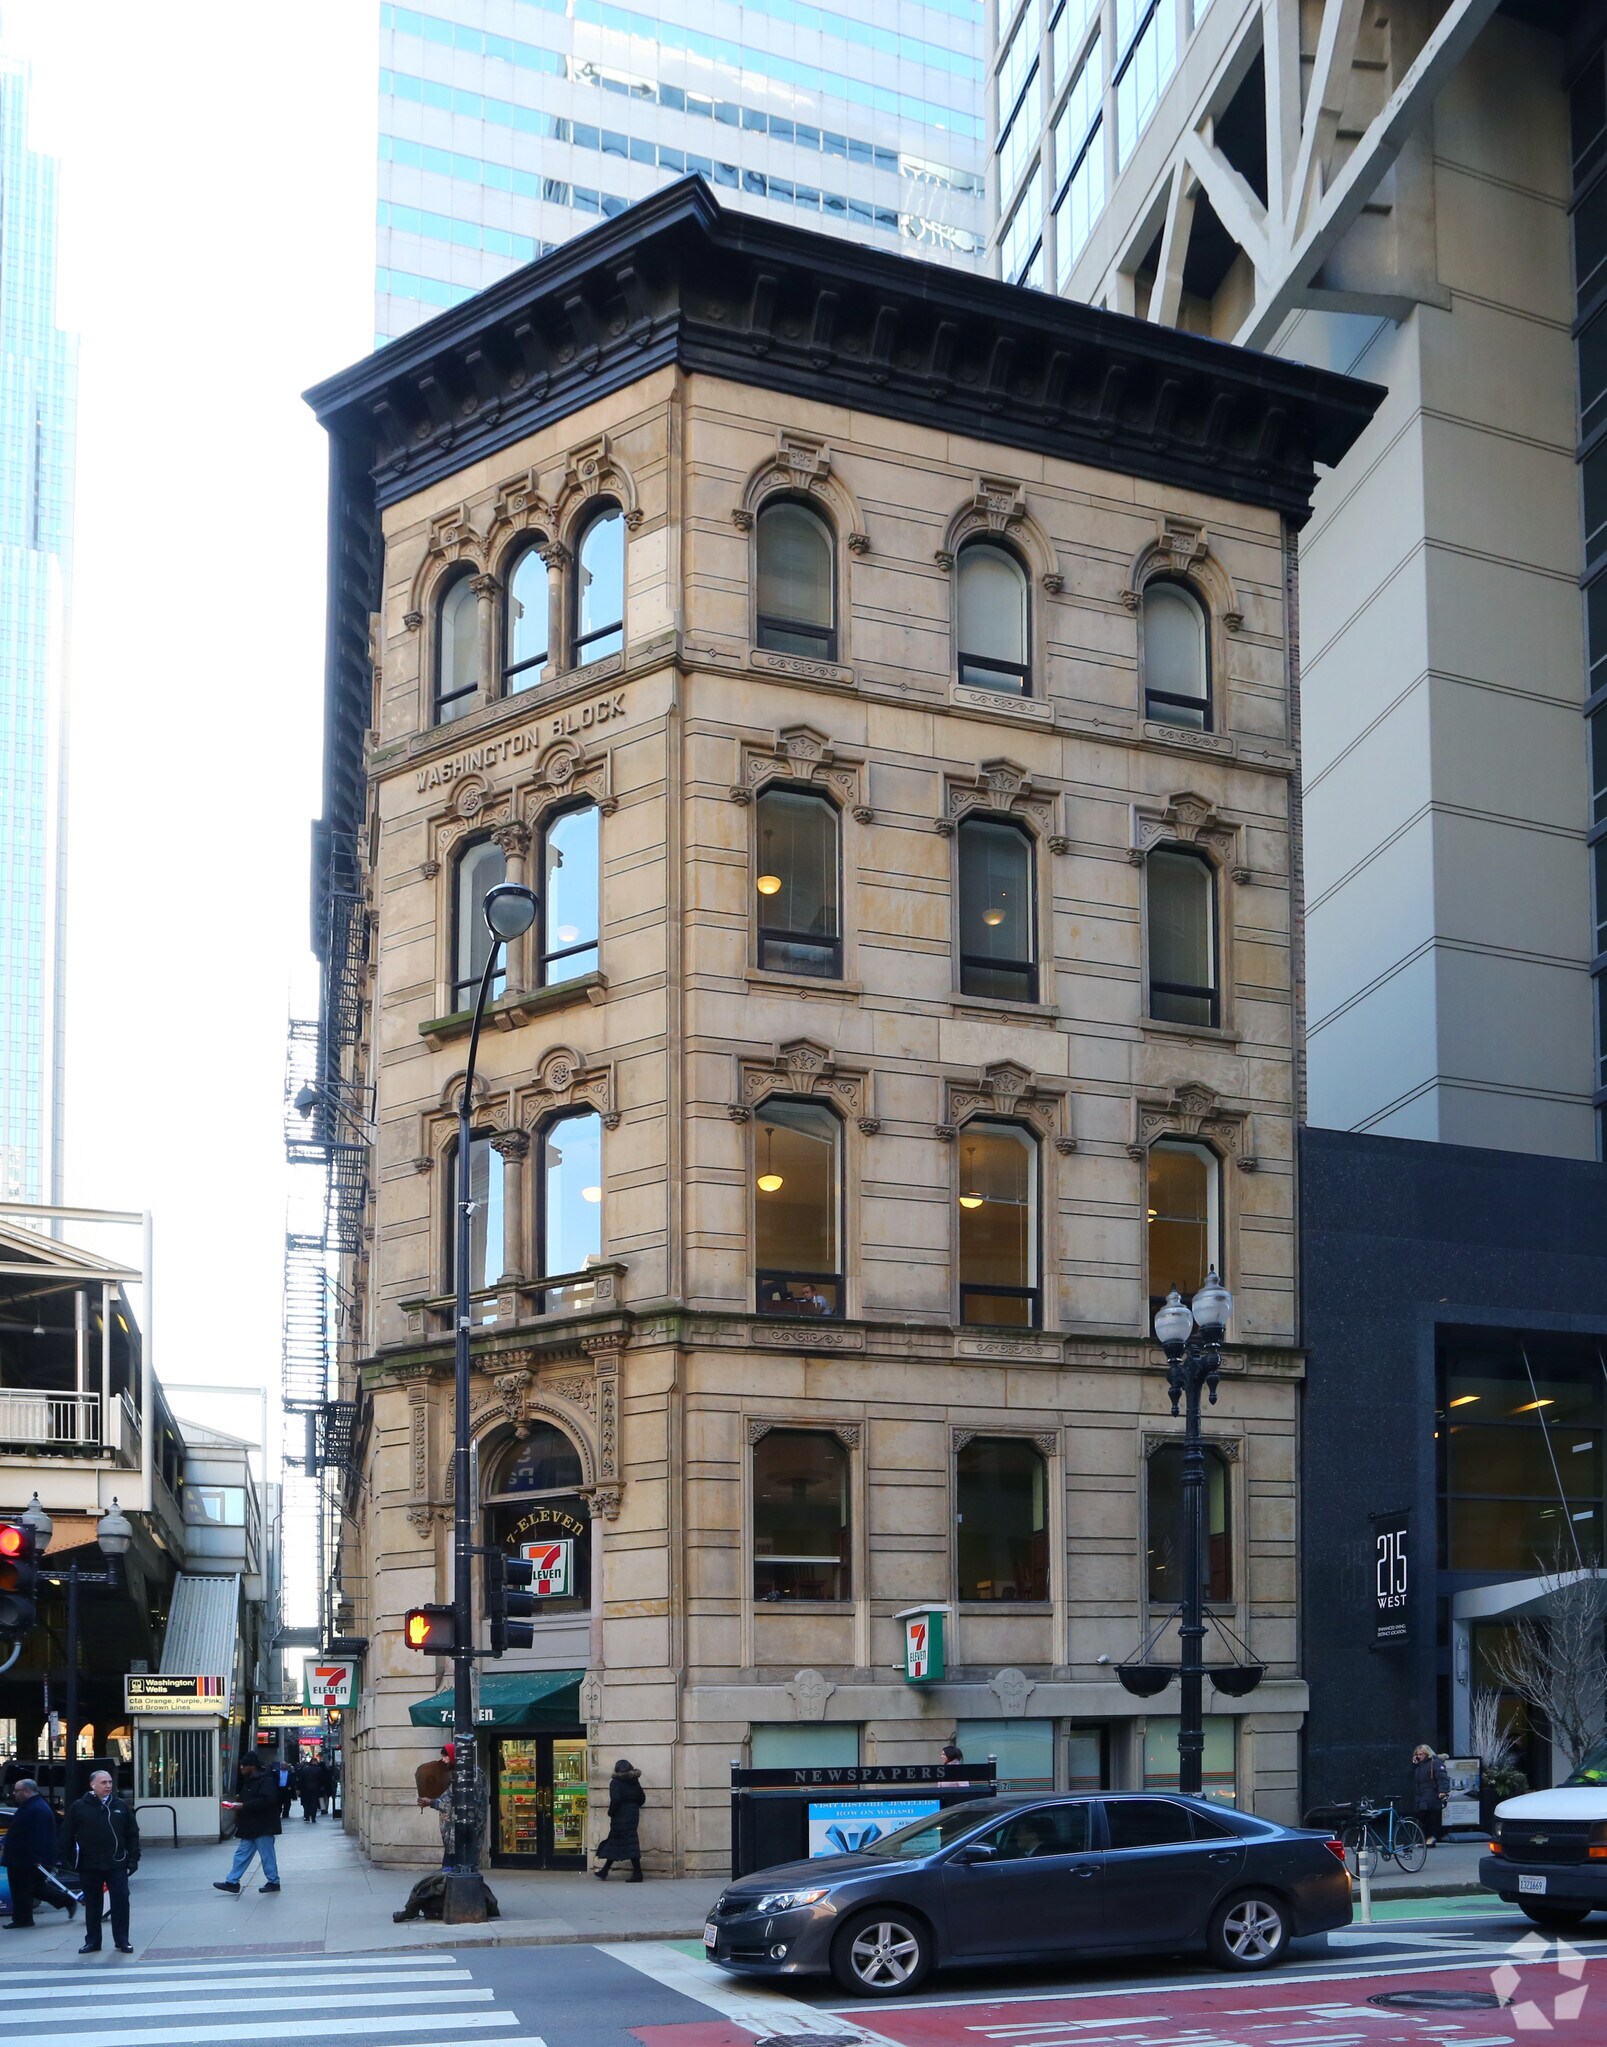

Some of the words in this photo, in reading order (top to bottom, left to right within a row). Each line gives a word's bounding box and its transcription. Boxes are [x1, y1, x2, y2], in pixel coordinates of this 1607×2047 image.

[416, 727, 539, 793] WASHINGTON
[552, 692, 626, 736] BLOCK
[529, 1545, 560, 1594] 7
[533, 1569, 561, 1580] LEVEn
[1377, 1530, 1407, 1597] 215
[1377, 1594, 1407, 1609] WEST
[911, 1623, 926, 1677] 7
[145, 1679, 196, 1688] Washington/
[315, 1667, 346, 1705] 7
[794, 1766, 946, 1783] NEWSPAPERS
